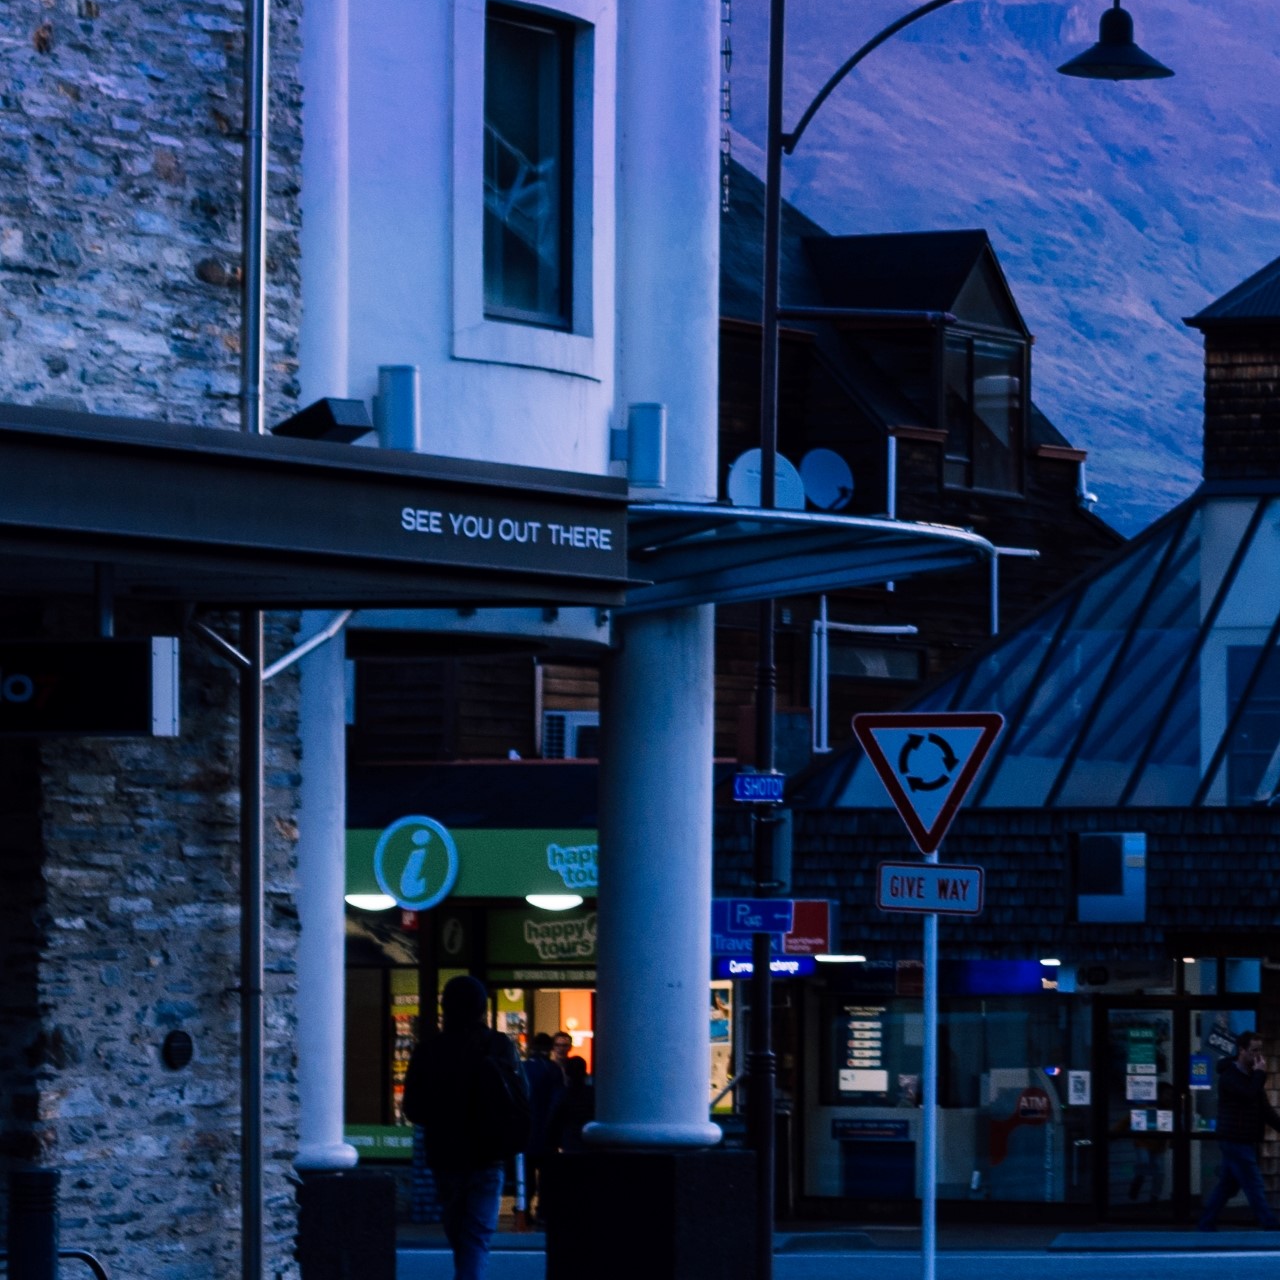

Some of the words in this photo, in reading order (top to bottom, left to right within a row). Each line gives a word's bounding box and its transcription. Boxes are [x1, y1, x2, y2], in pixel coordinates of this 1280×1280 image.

[401, 506, 443, 535] SEE
[448, 512, 494, 540] YOU
[498, 517, 543, 545] OUT
[547, 523, 613, 552] THERE
[744, 777, 783, 796] SHOTO
[565, 867, 598, 883] tou
[889, 876, 926, 899] GIVE
[937, 878, 971, 902] WAY
[735, 903, 751, 925] P
[527, 922, 585, 944] happy
[713, 934, 778, 951] Travex
[540, 938, 592, 956] tours
[1019, 1095, 1048, 1109] ATM
